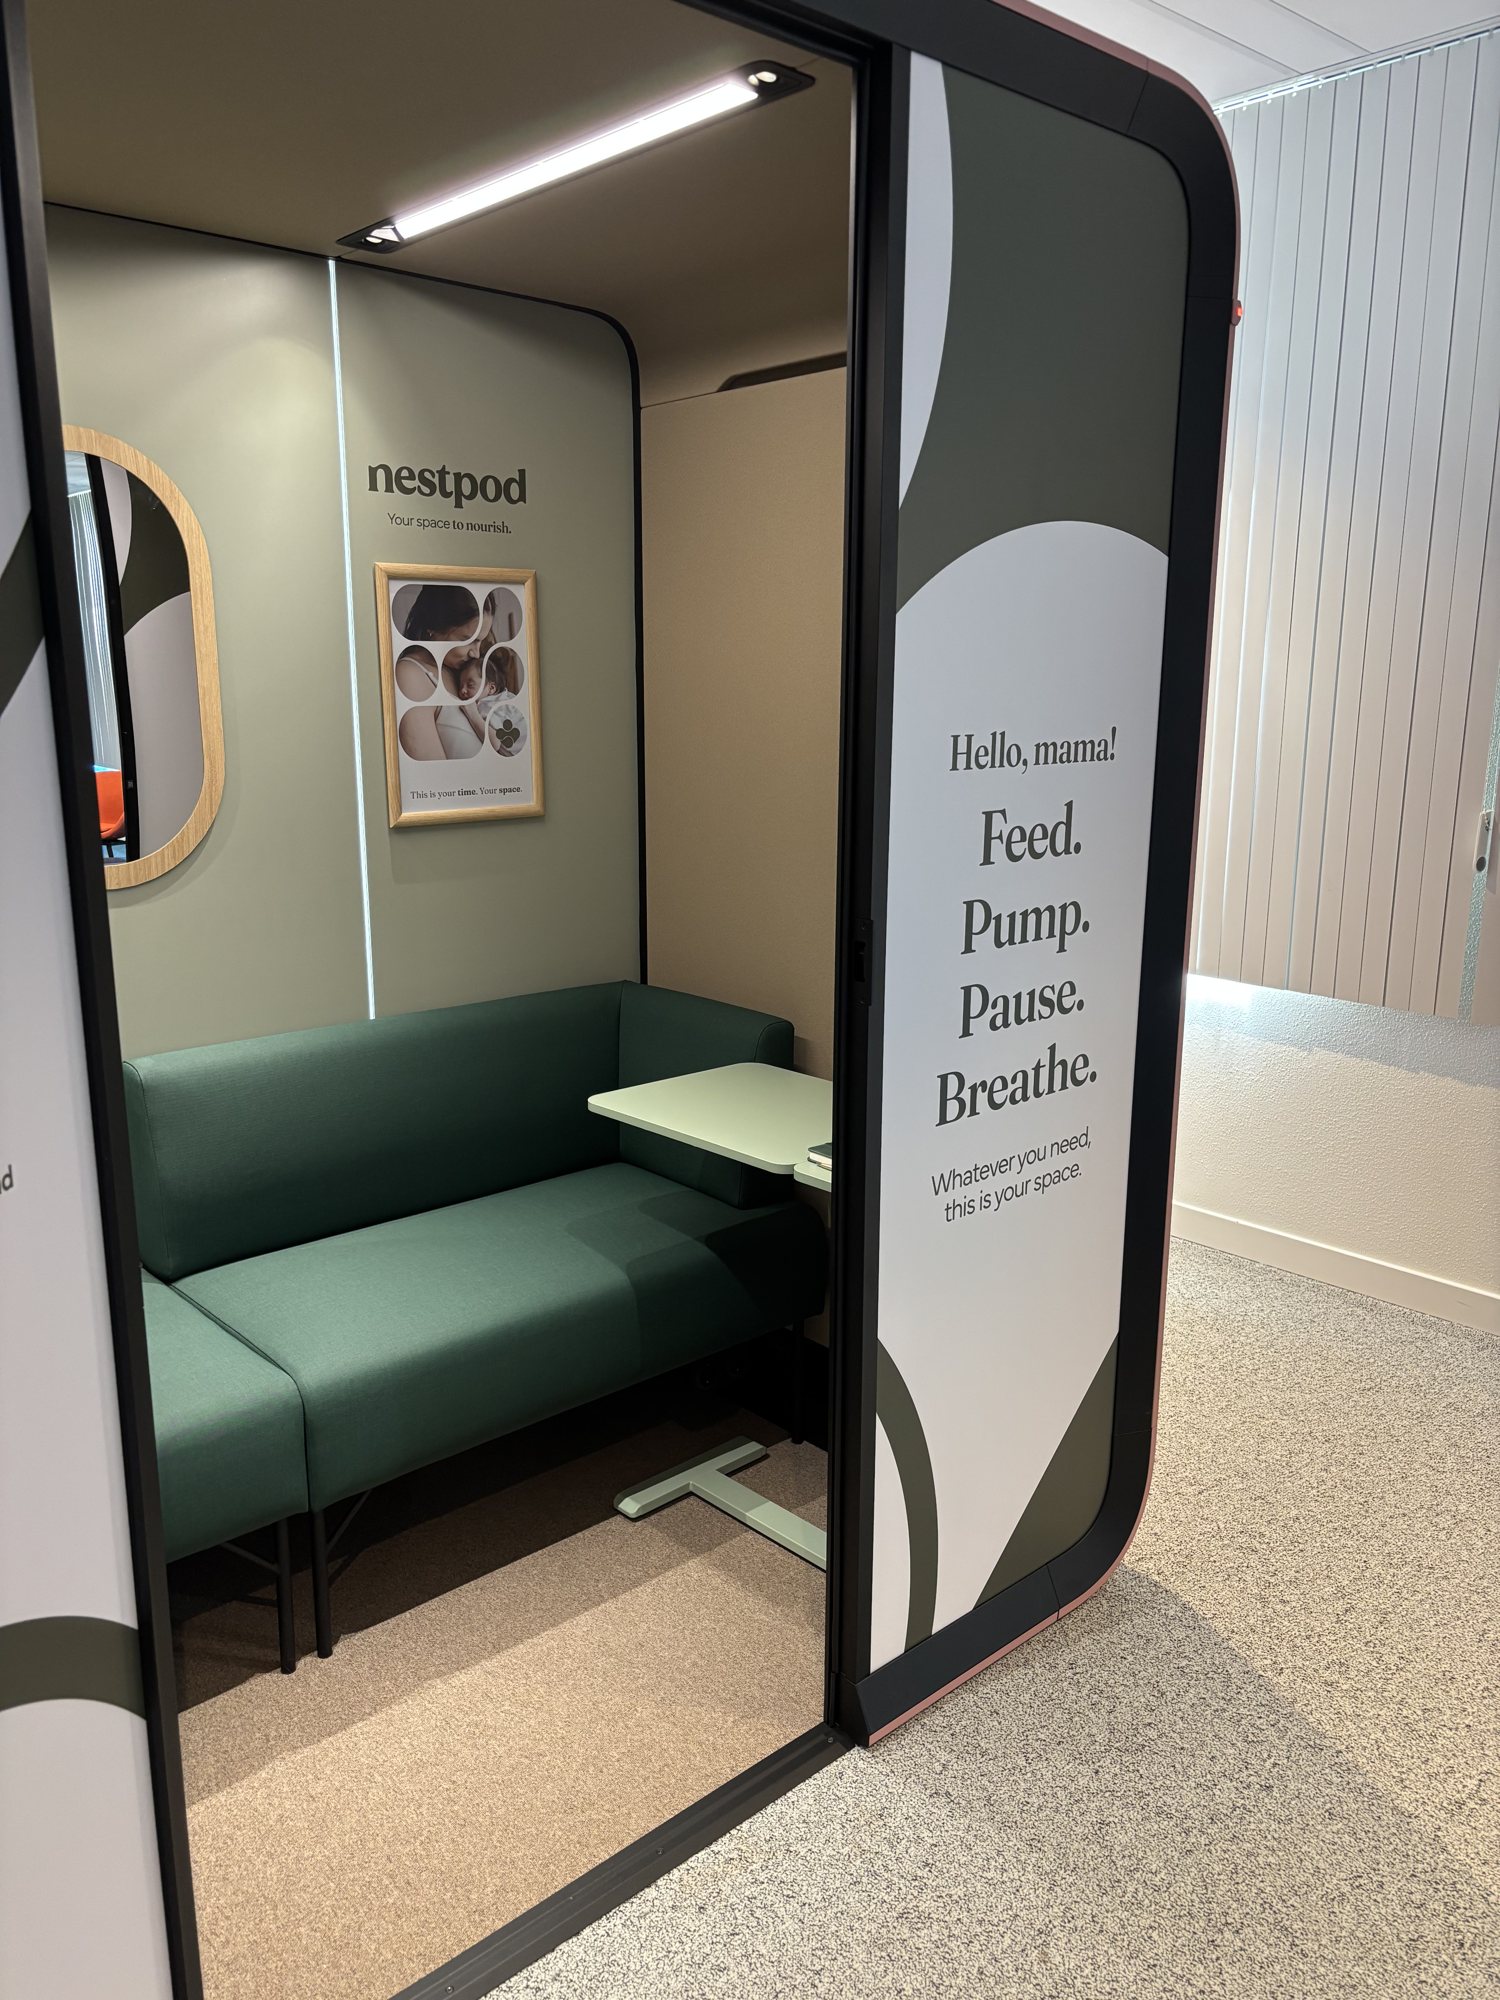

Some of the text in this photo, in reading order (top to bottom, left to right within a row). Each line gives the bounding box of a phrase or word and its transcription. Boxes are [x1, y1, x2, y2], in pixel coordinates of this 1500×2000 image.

[368, 463, 527, 509] nestpod
[387, 512, 512, 534] Your space to nourish.
[949, 726, 1117, 775] Hello, mama!
[410, 786, 523, 800] This is your time. Your space.
[979, 799, 1082, 867] Feed.
[960, 898, 1090, 955] Pump.
[958, 980, 1085, 1039] Pause.
[935, 1043, 1097, 1127] Breathe.
[931, 1126, 1092, 1196] Whatever you need,
[944, 1163, 1082, 1223] this is your space.
